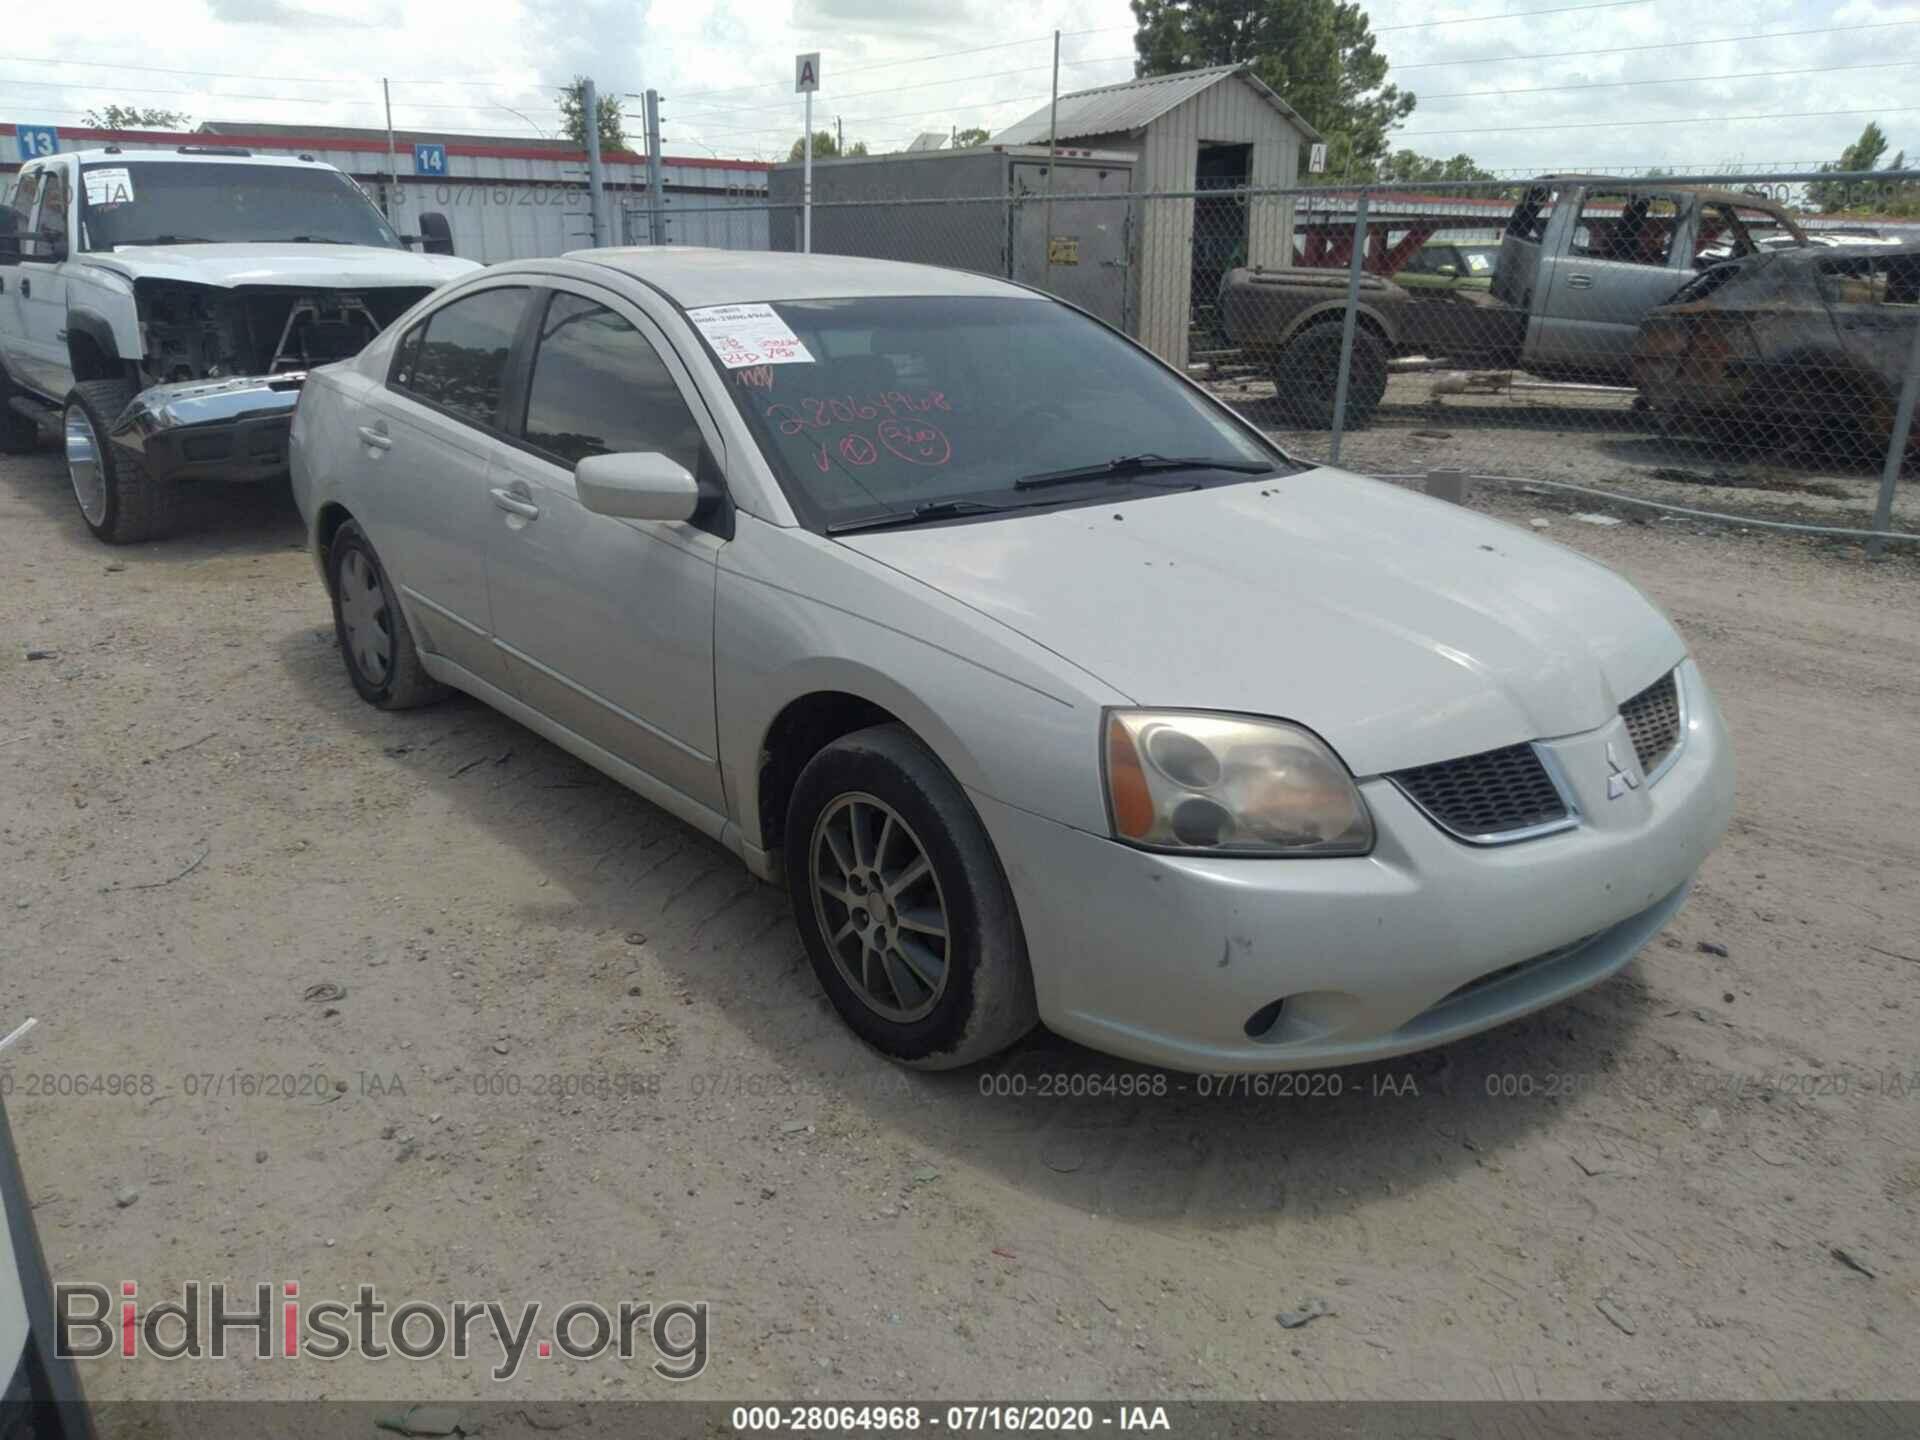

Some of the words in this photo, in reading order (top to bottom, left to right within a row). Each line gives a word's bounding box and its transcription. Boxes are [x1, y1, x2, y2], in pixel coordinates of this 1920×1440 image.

[801, 61, 815, 85] A
[24, 132, 53, 156] 13
[420, 150, 442, 170] 14
